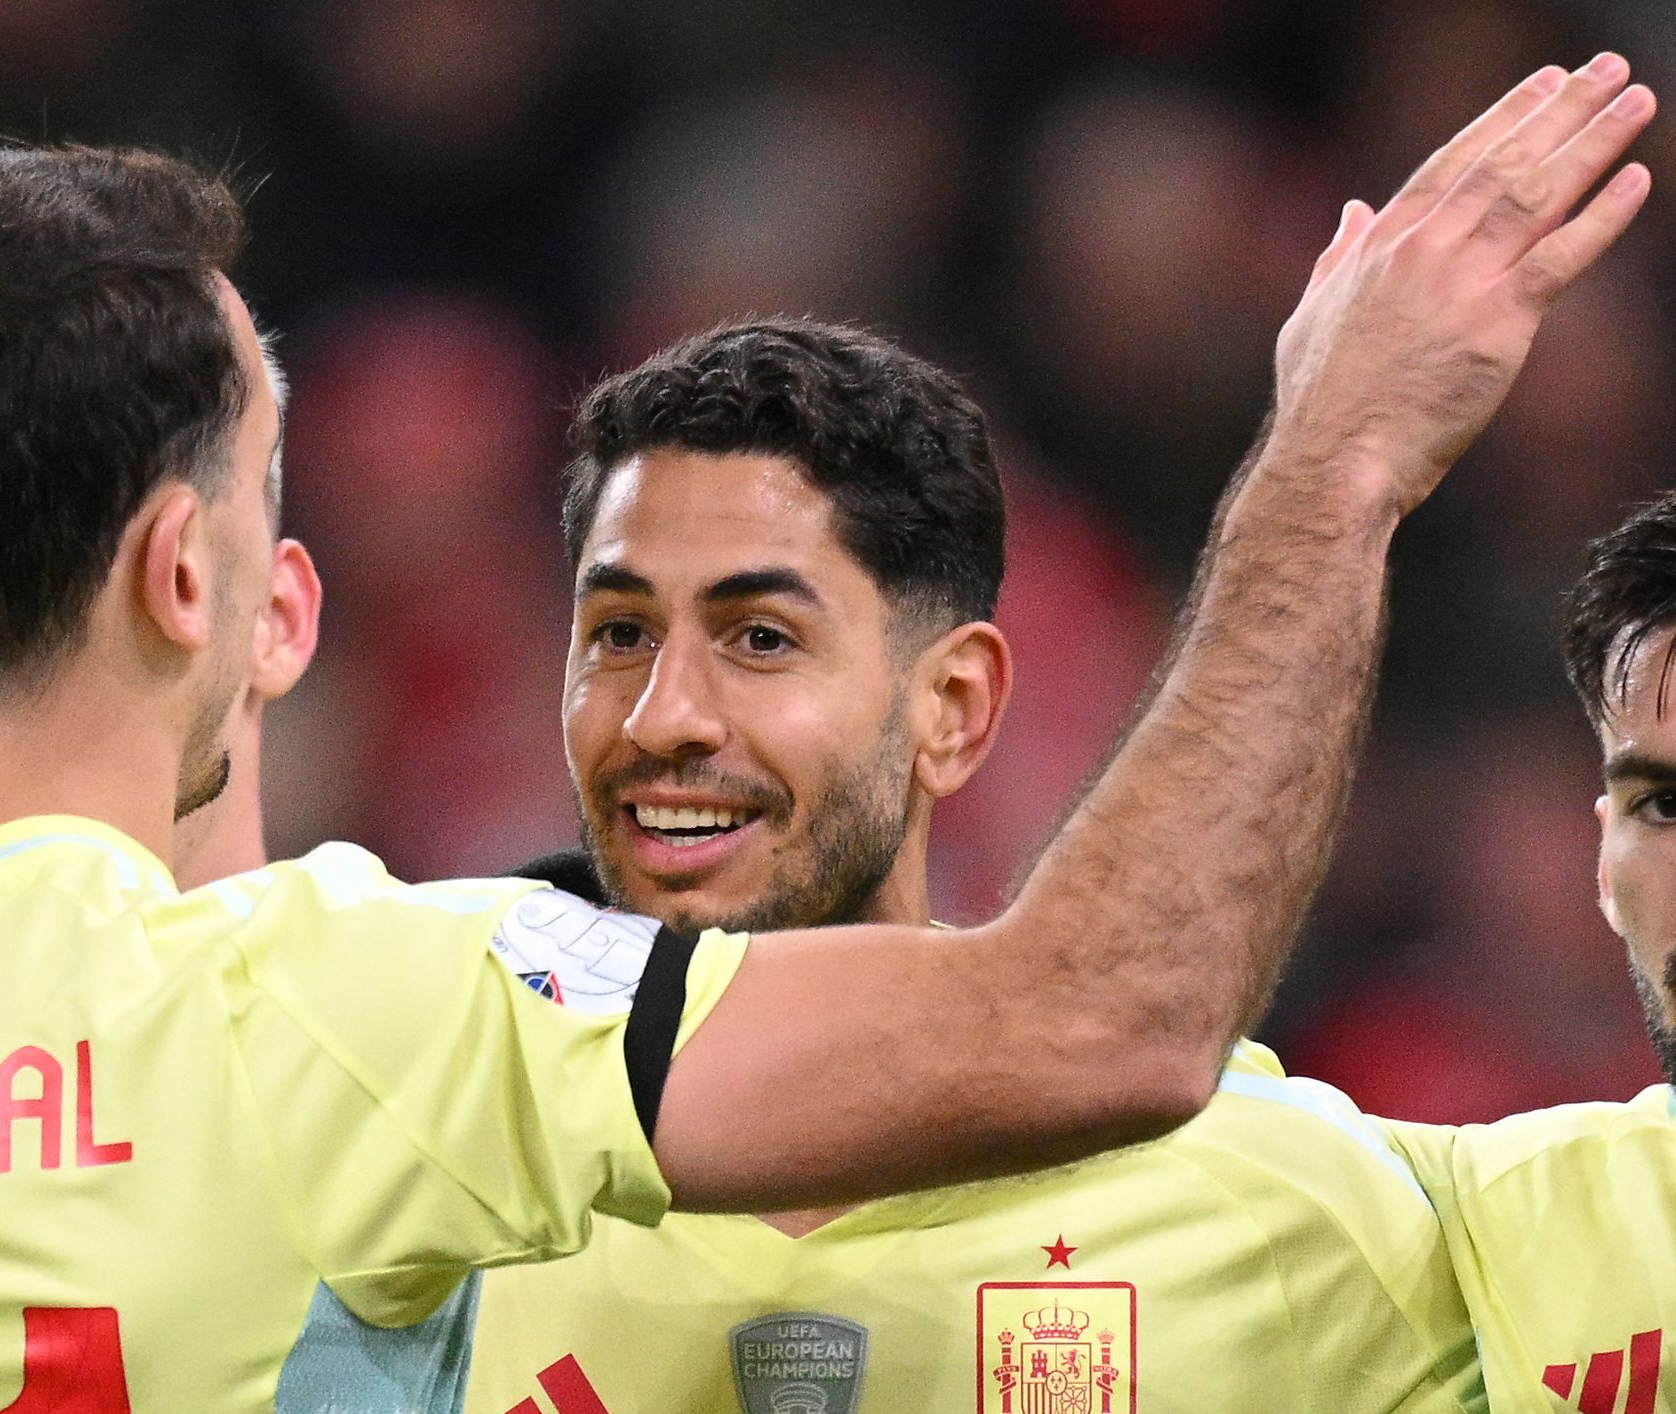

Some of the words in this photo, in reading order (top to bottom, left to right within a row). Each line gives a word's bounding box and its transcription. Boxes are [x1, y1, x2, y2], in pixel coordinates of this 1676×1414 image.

[778, 1324, 820, 1338] UEFA
[743, 1343, 853, 1360] EUROPEAN
[743, 1361, 854, 1378] CHAMPIONS
